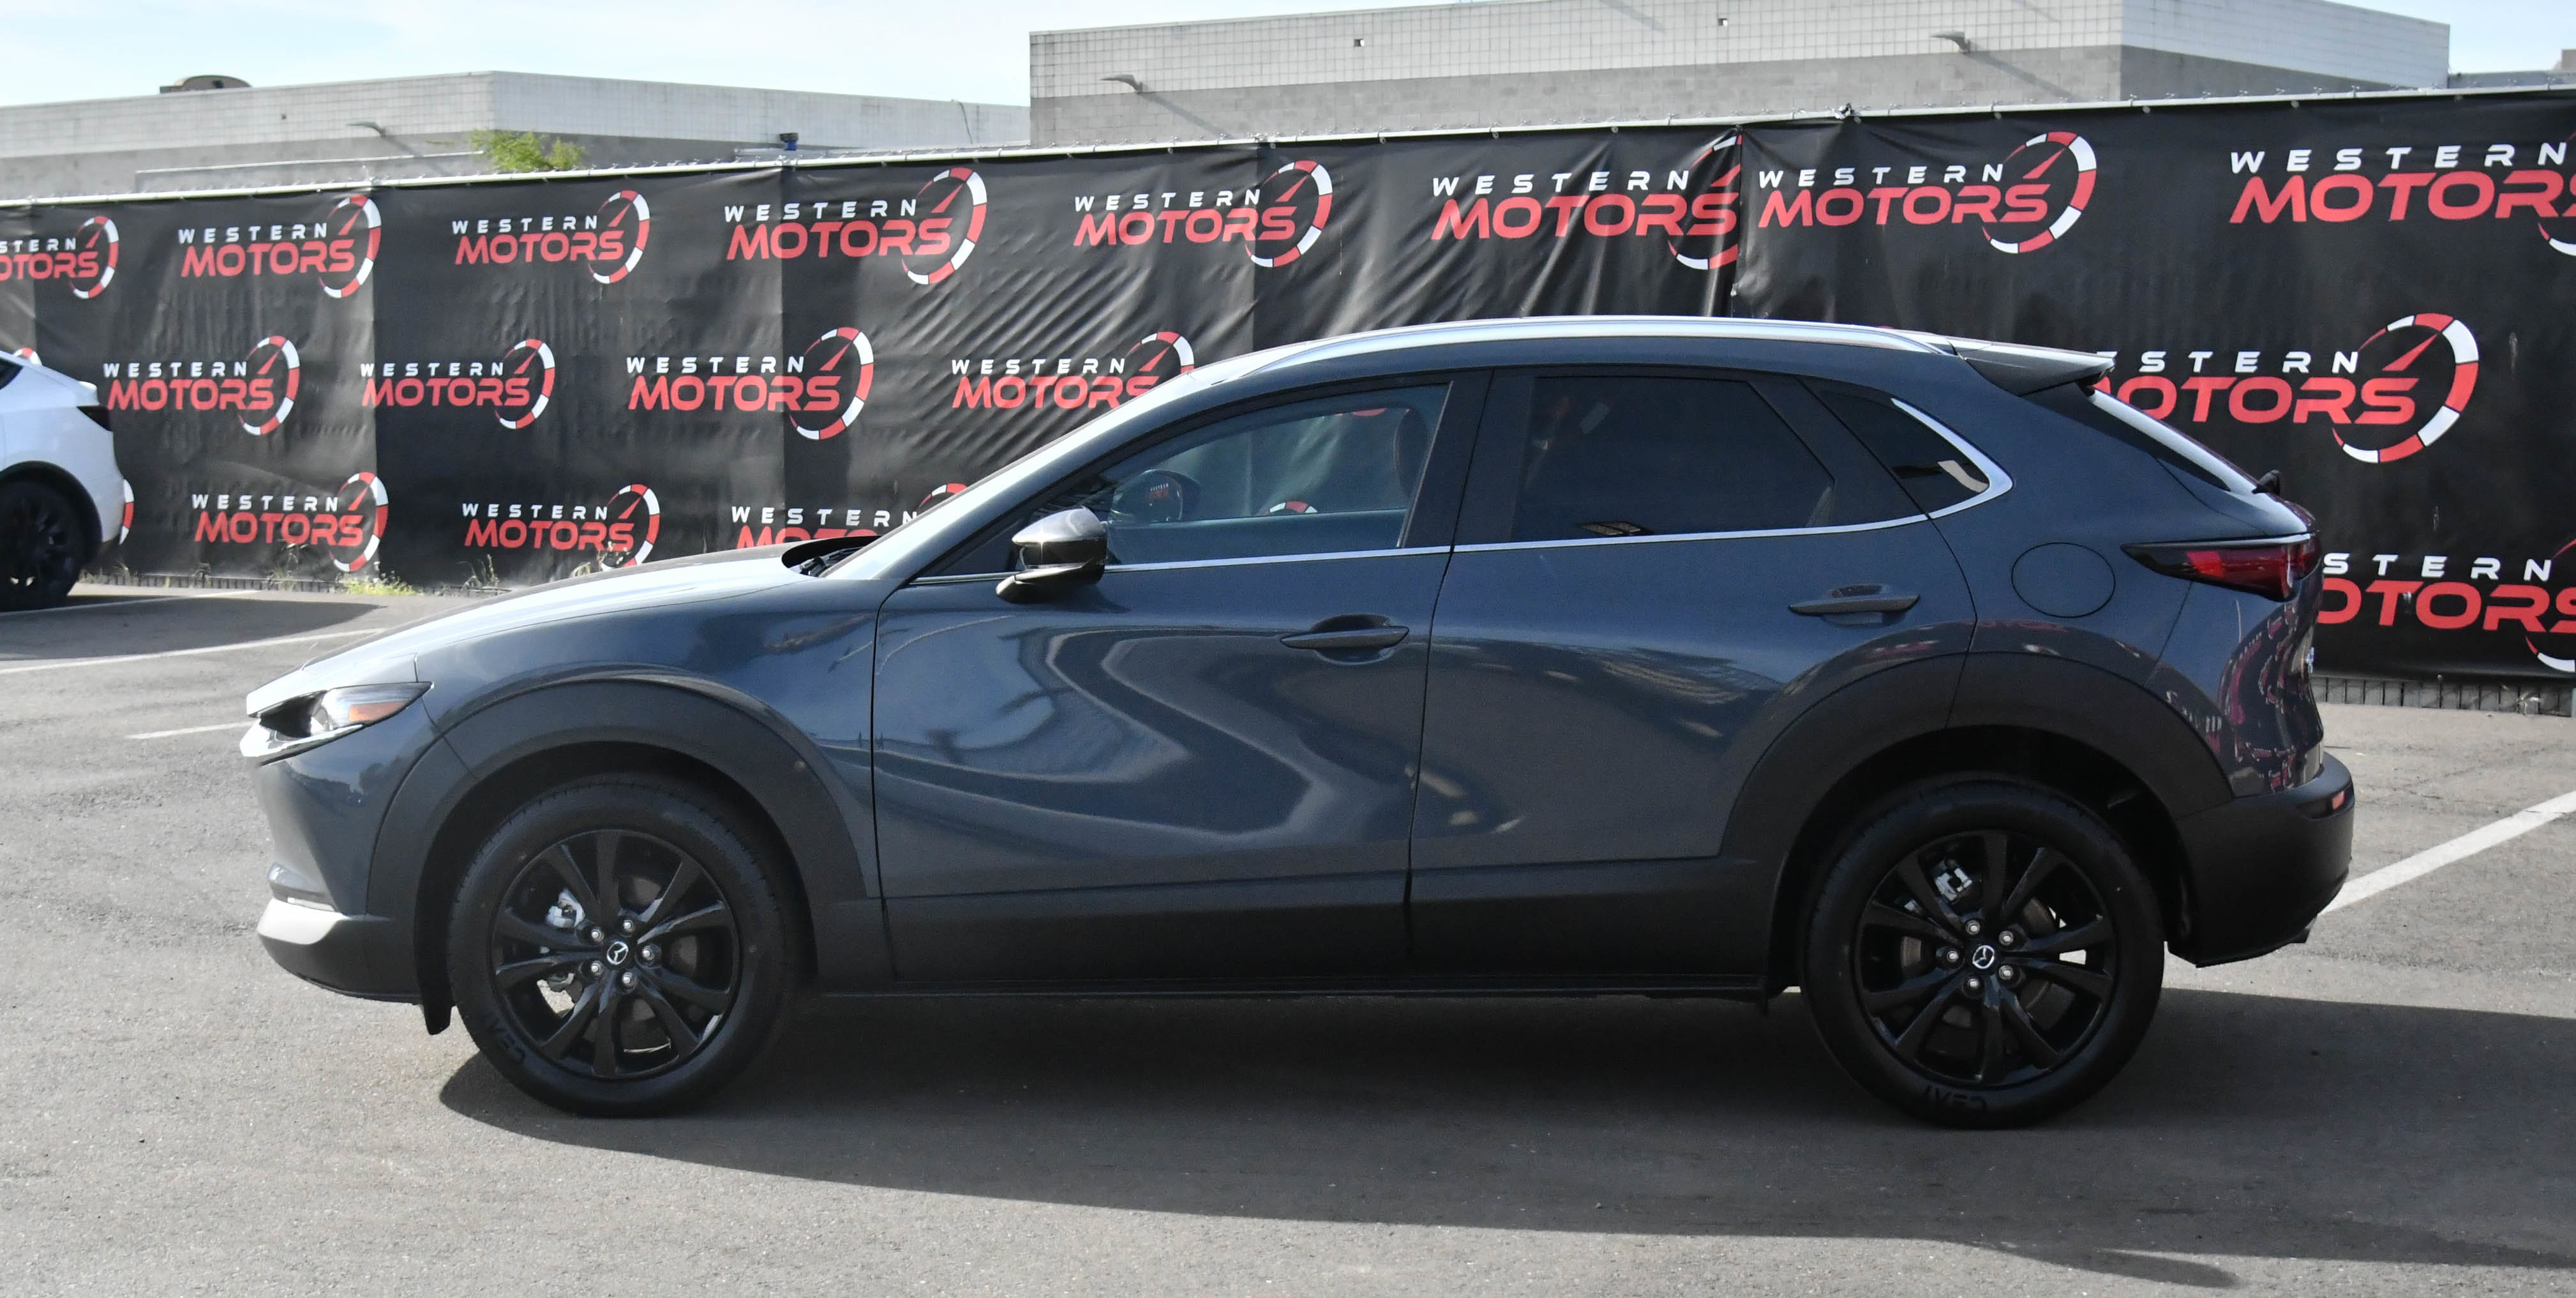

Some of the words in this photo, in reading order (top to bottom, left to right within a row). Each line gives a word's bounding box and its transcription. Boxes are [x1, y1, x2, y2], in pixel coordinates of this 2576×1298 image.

[2231, 142, 2566, 174] WESTERN
[1433, 170, 1689, 197] WESTERN
[1759, 163, 2003, 189] WESTERN
[724, 199, 917, 223] WESTERN
[1075, 188, 1261, 212] WESTERN
[1758, 183, 2050, 229] MOTORS
[2229, 169, 2576, 223] MOTOR
[452, 215, 597, 234] WESTERN
[1074, 206, 1296, 246] MOTORS
[1431, 192, 1739, 241] MOTORS
[0, 238, 76, 254] STERN
[178, 222, 327, 244] WESTERN
[455, 229, 624, 265] MOTORS
[727, 218, 952, 260] MOTORS
[0, 251, 99, 282] OTORS
[182, 239, 355, 277] MOTORS
[103, 361, 247, 378] WESTERN
[360, 361, 504, 378] WESTERN
[626, 356, 804, 374] WESTERN
[951, 358, 1125, 377] WESTERN
[2095, 351, 2358, 374] STERN
[107, 378, 274, 411] MOTORS
[362, 377, 530, 407] MOTORS
[628, 374, 841, 412] MOTORS
[2093, 375, 2419, 425] OTORS
[192, 494, 340, 512] WESTERN
[462, 503, 608, 520] WESTERN
[195, 511, 363, 547] MOTORS
[464, 518, 634, 553] MOTORS
[2323, 552, 2551, 581] STERN
[2318, 577, 2576, 634] OTOR
